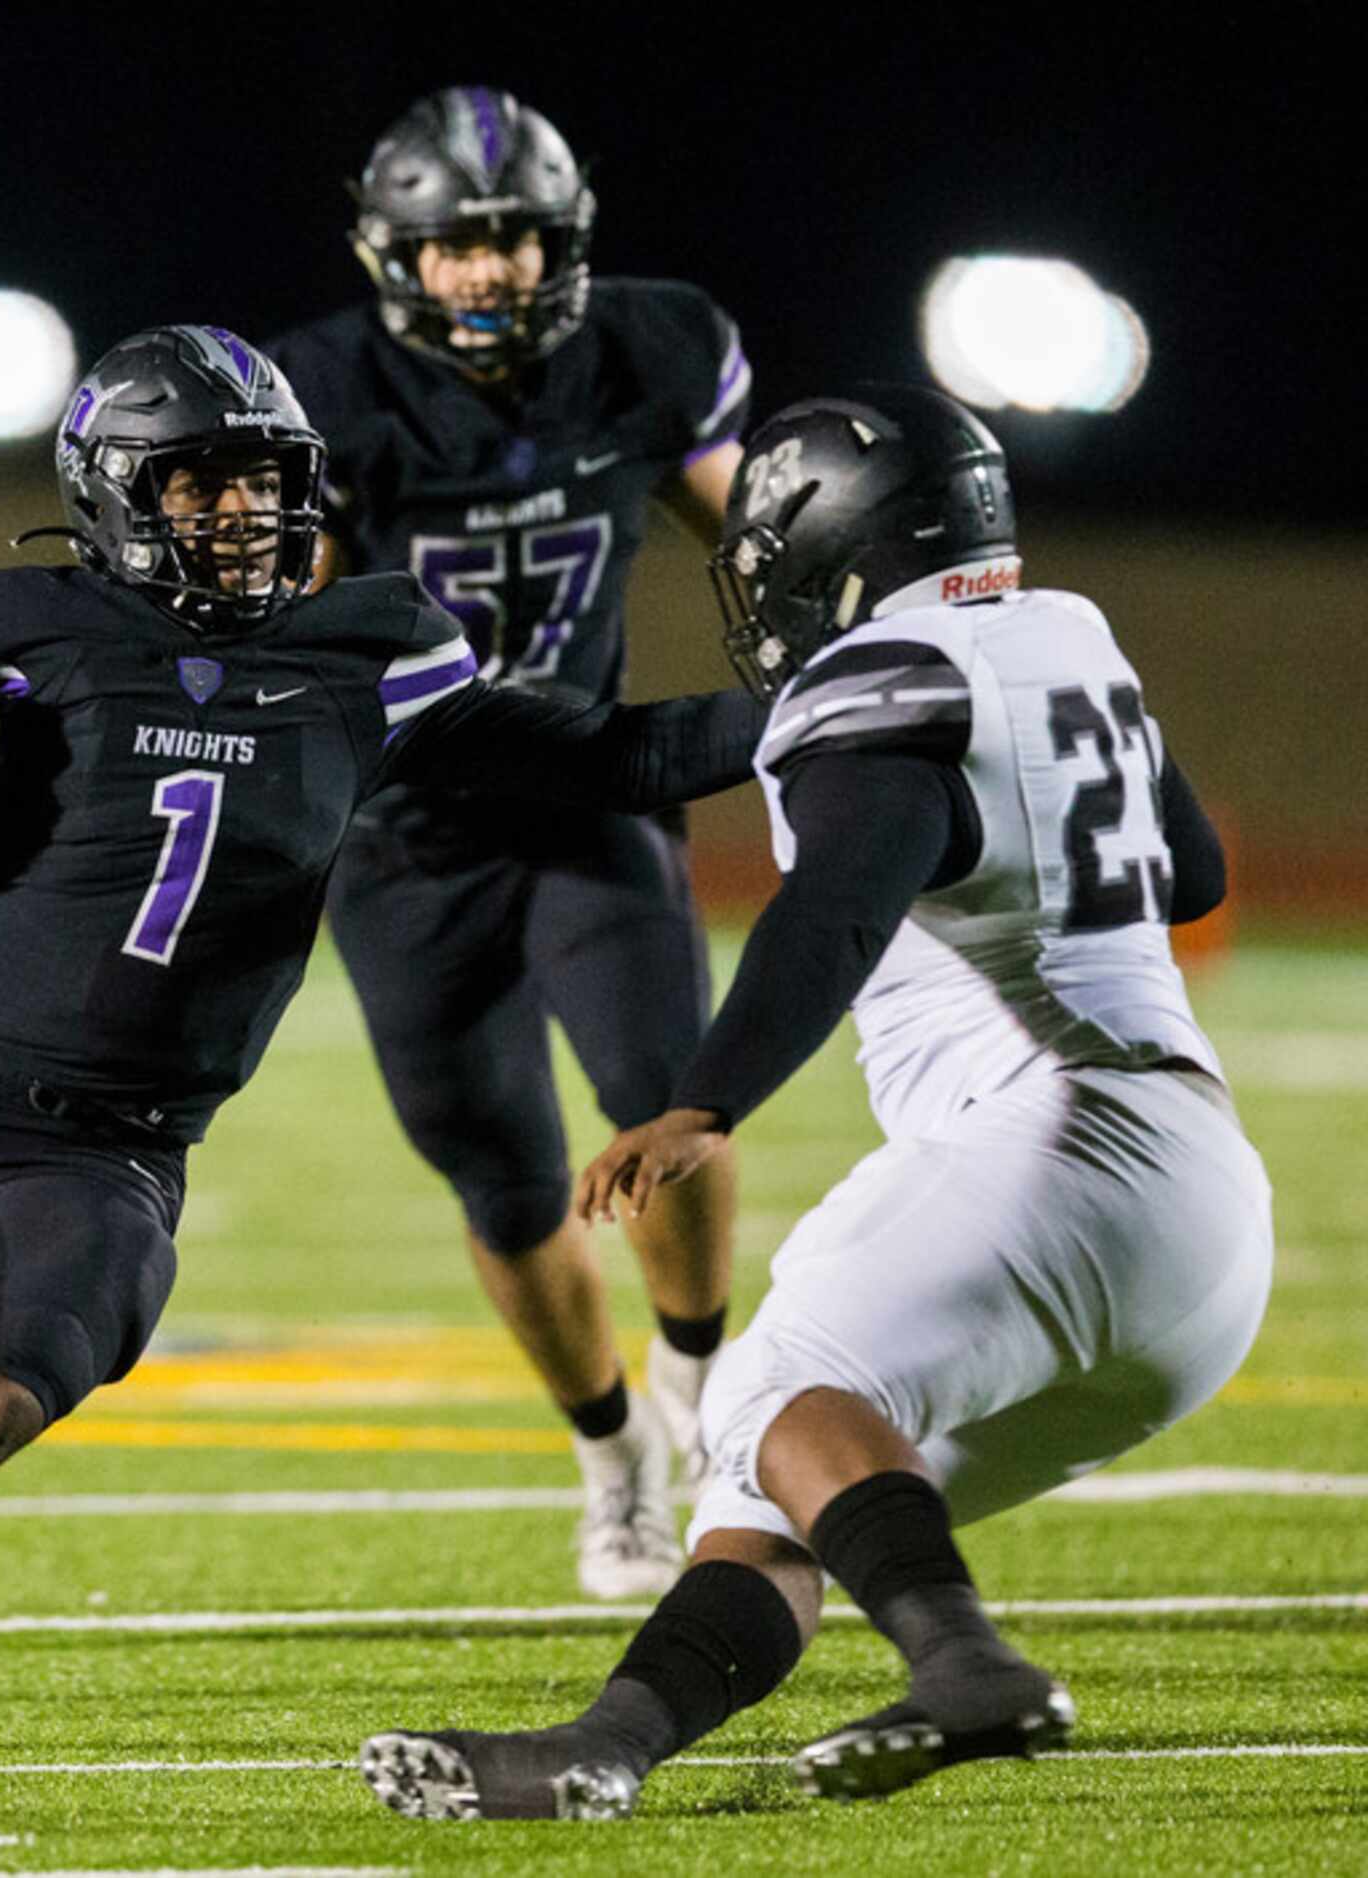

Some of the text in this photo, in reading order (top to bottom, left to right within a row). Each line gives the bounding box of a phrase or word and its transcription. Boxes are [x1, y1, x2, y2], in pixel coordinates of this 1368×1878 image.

[745, 437, 803, 521] 23
[410, 512, 612, 683] 57
[133, 725, 257, 765] KNIGHTS
[121, 768, 225, 967] 1
